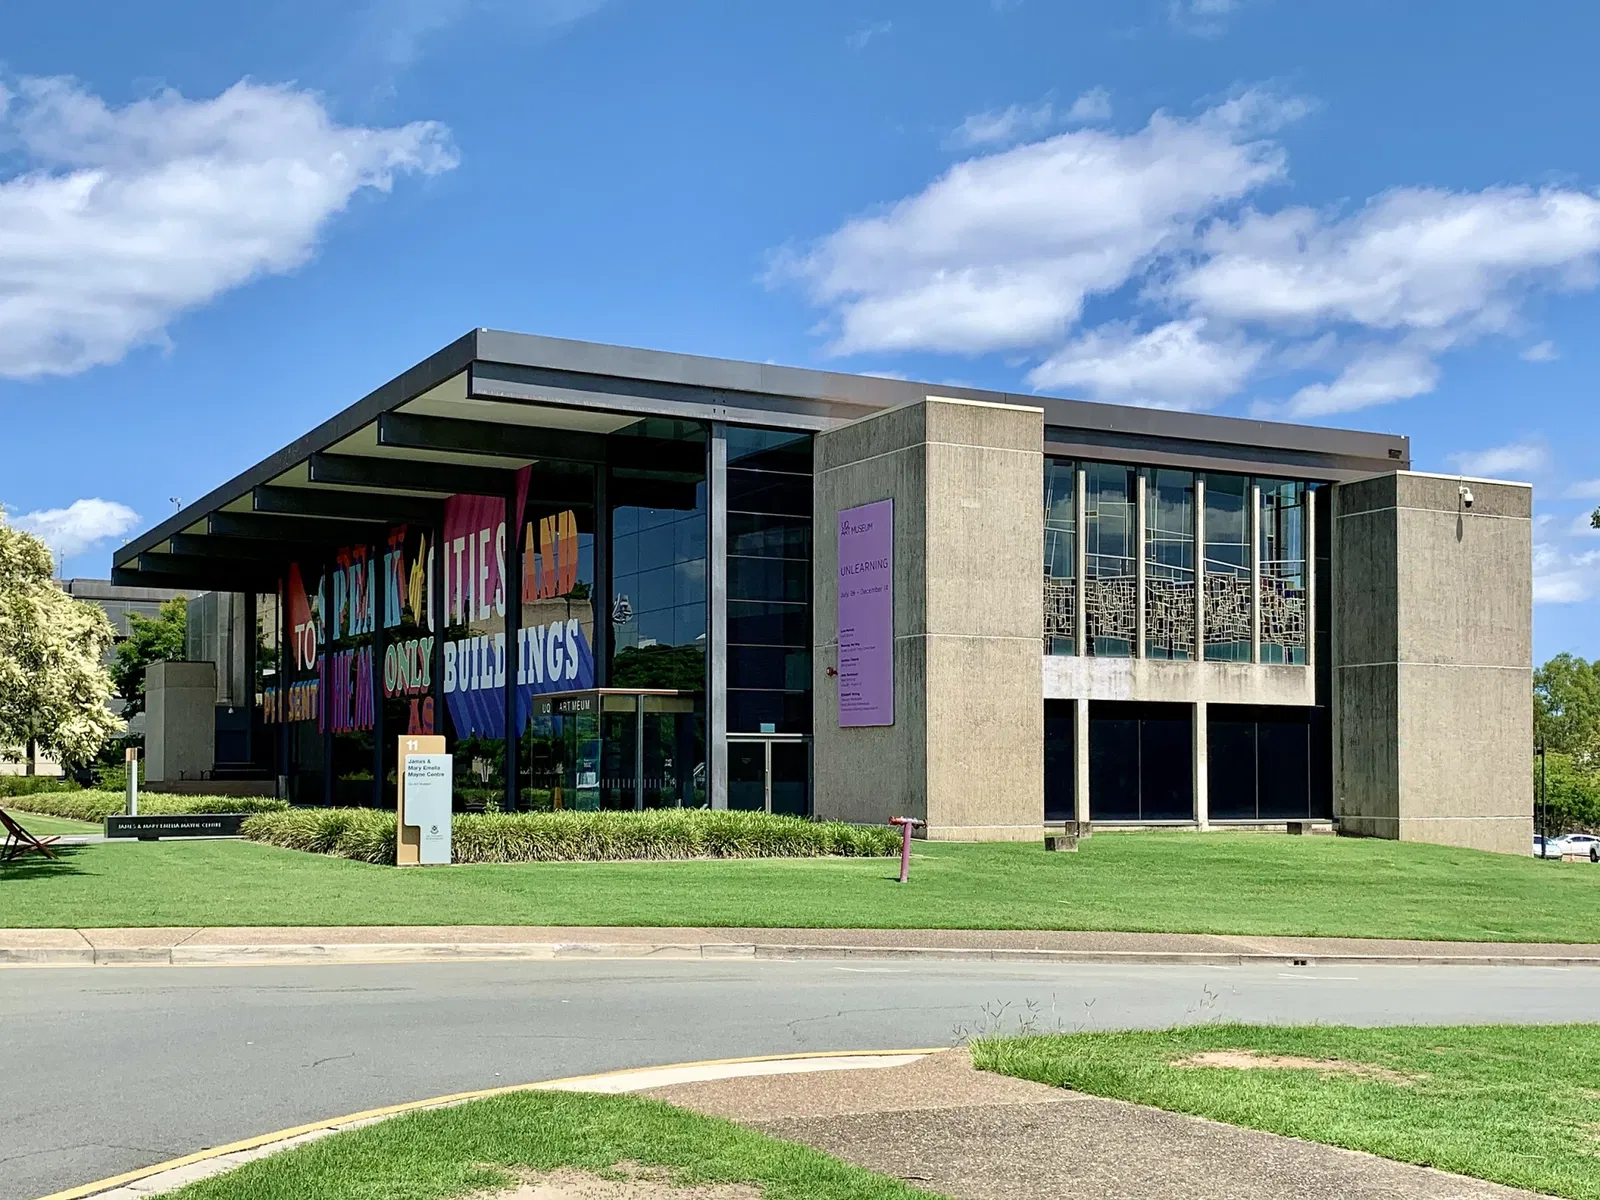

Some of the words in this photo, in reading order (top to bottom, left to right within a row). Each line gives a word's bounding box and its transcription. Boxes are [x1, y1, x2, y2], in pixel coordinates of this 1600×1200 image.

[841, 527, 851, 537] ART
[851, 523, 873, 535] MUSEUM
[840, 558, 889, 577] UNLEARNING
[295, 620, 316, 671] TO
[317, 549, 402, 644] SPEAK
[427, 522, 506, 633] CITIES
[522, 510, 579, 601] AND
[860, 586, 882, 596] December
[317, 645, 375, 734] THEM
[384, 636, 435, 695] ONLY
[444, 618, 580, 693] BUILDINGS
[541, 702, 551, 713] UQ
[559, 701, 570, 712] ART
[407, 740, 418, 751] 11
